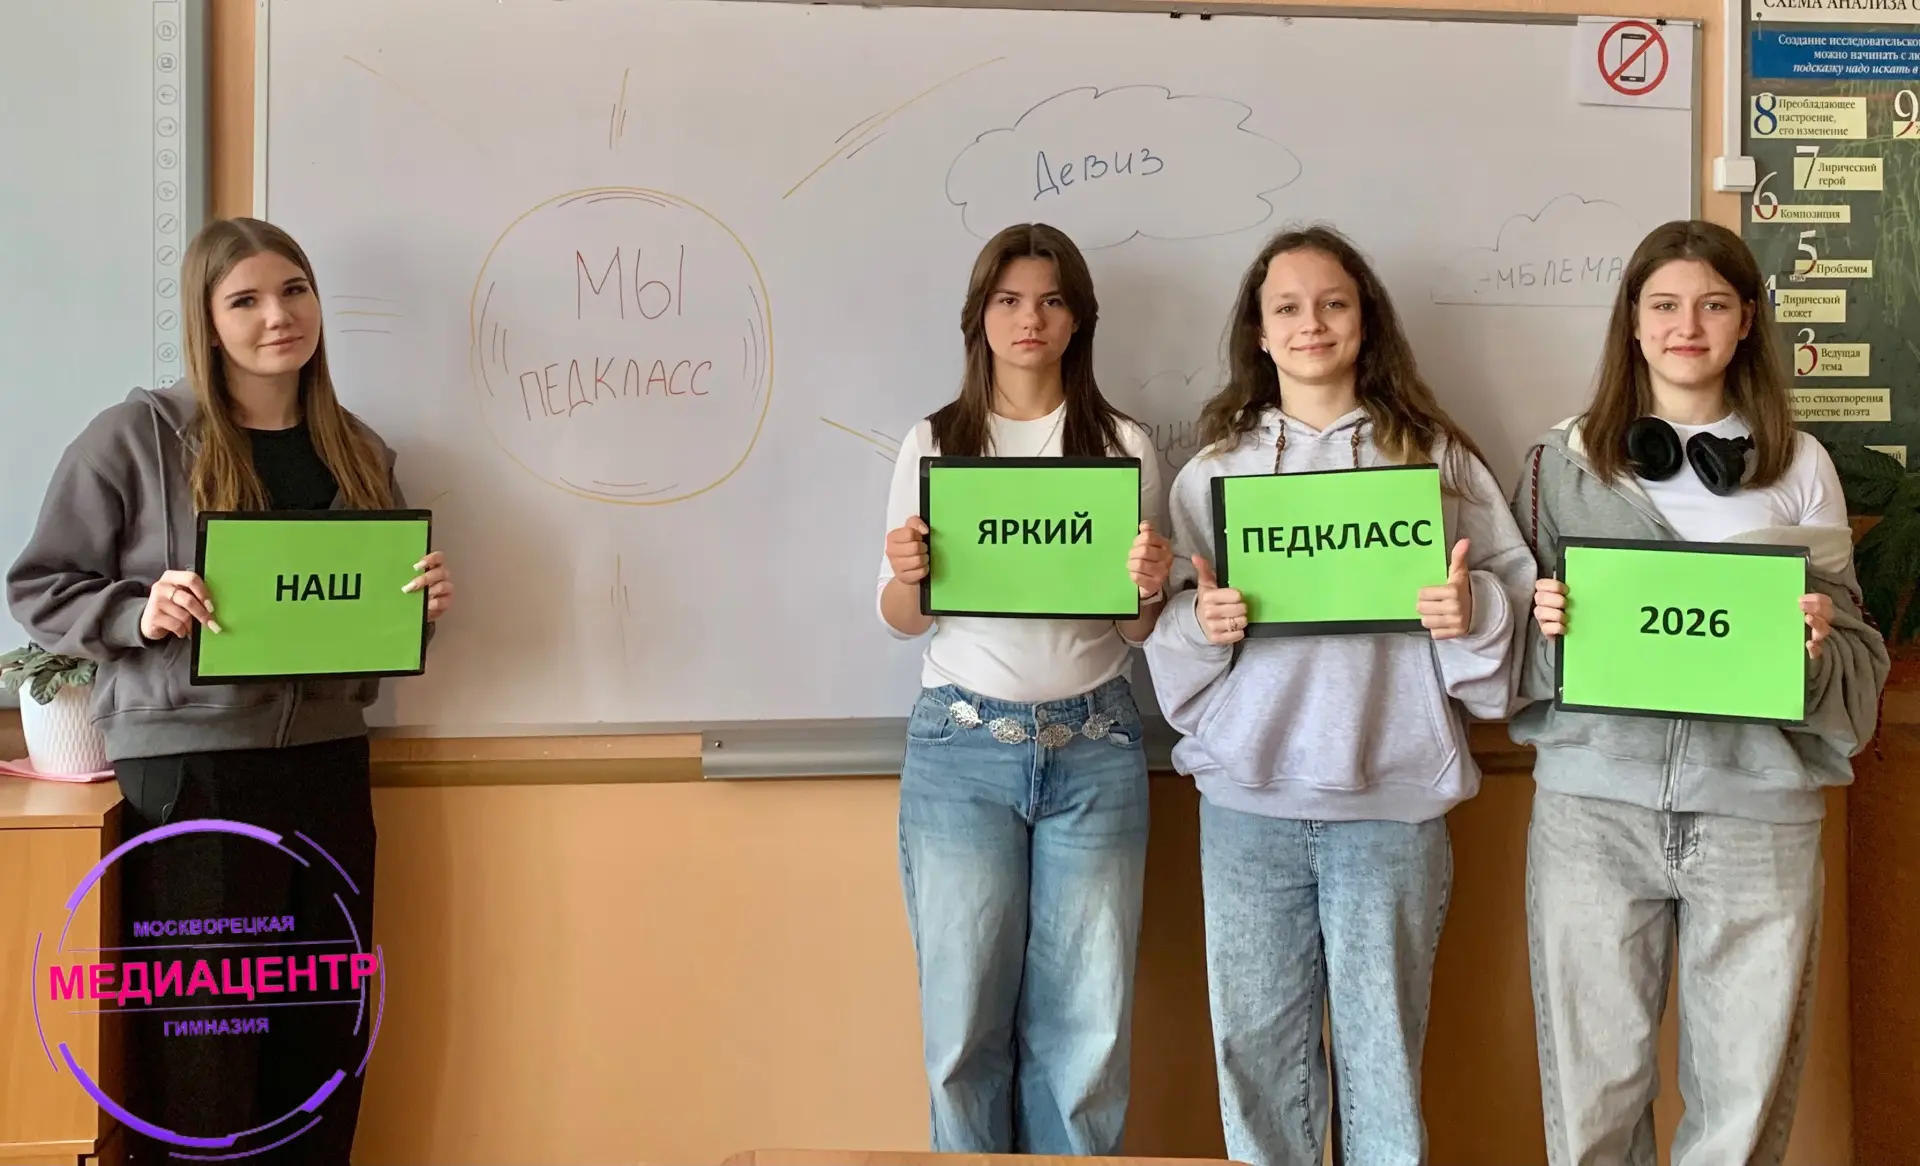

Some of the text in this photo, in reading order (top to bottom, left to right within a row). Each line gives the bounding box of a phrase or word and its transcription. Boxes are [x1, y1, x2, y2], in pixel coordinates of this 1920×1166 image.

[1763, 0, 1822, 9] СХЕМА
[1827, 0, 1907, 10] АНАЛИЗА
[1778, 34, 1920, 47] Создание исследовательско
[1813, 51, 1848, 60] можно
[1850, 51, 1899, 60] начинать
[1793, 62, 1844, 76] подсказку
[1845, 63, 1870, 74] надо
[1872, 65, 1911, 74] искать
[1779, 99, 1856, 111] Преобладающее
[1754, 92, 1777, 135] 8
[1894, 90, 1919, 137] 9
[1779, 128, 1849, 137] его изменение
[1796, 145, 1820, 188] 7
[1818, 162, 1877, 174] Лирический
[1819, 176, 1846, 188] герой
[1753, 171, 1779, 220] 6
[1780, 208, 1841, 219] Композиция
[1797, 229, 1817, 275] 5
[1816, 263, 1868, 275] Проблемы
[576, 244, 683, 320] МЫ
[1782, 294, 1840, 307] Лирический
[1783, 310, 1813, 318] сюжет
[1797, 327, 1818, 375] 3
[1821, 347, 1861, 360] Ведущая
[1821, 363, 1843, 371] тема
[519, 357, 712, 421] ПЕДКЛАСС
[1787, 395, 1884, 406] есто стихотворения
[1793, 408, 1870, 419] ворчестве поэта
[977, 511, 1093, 545] ЯРКИЙ
[1242, 519, 1432, 558] ПЕДКЛАСС
[276, 573, 361, 601] НАШ
[1640, 606, 1730, 638] 2026
